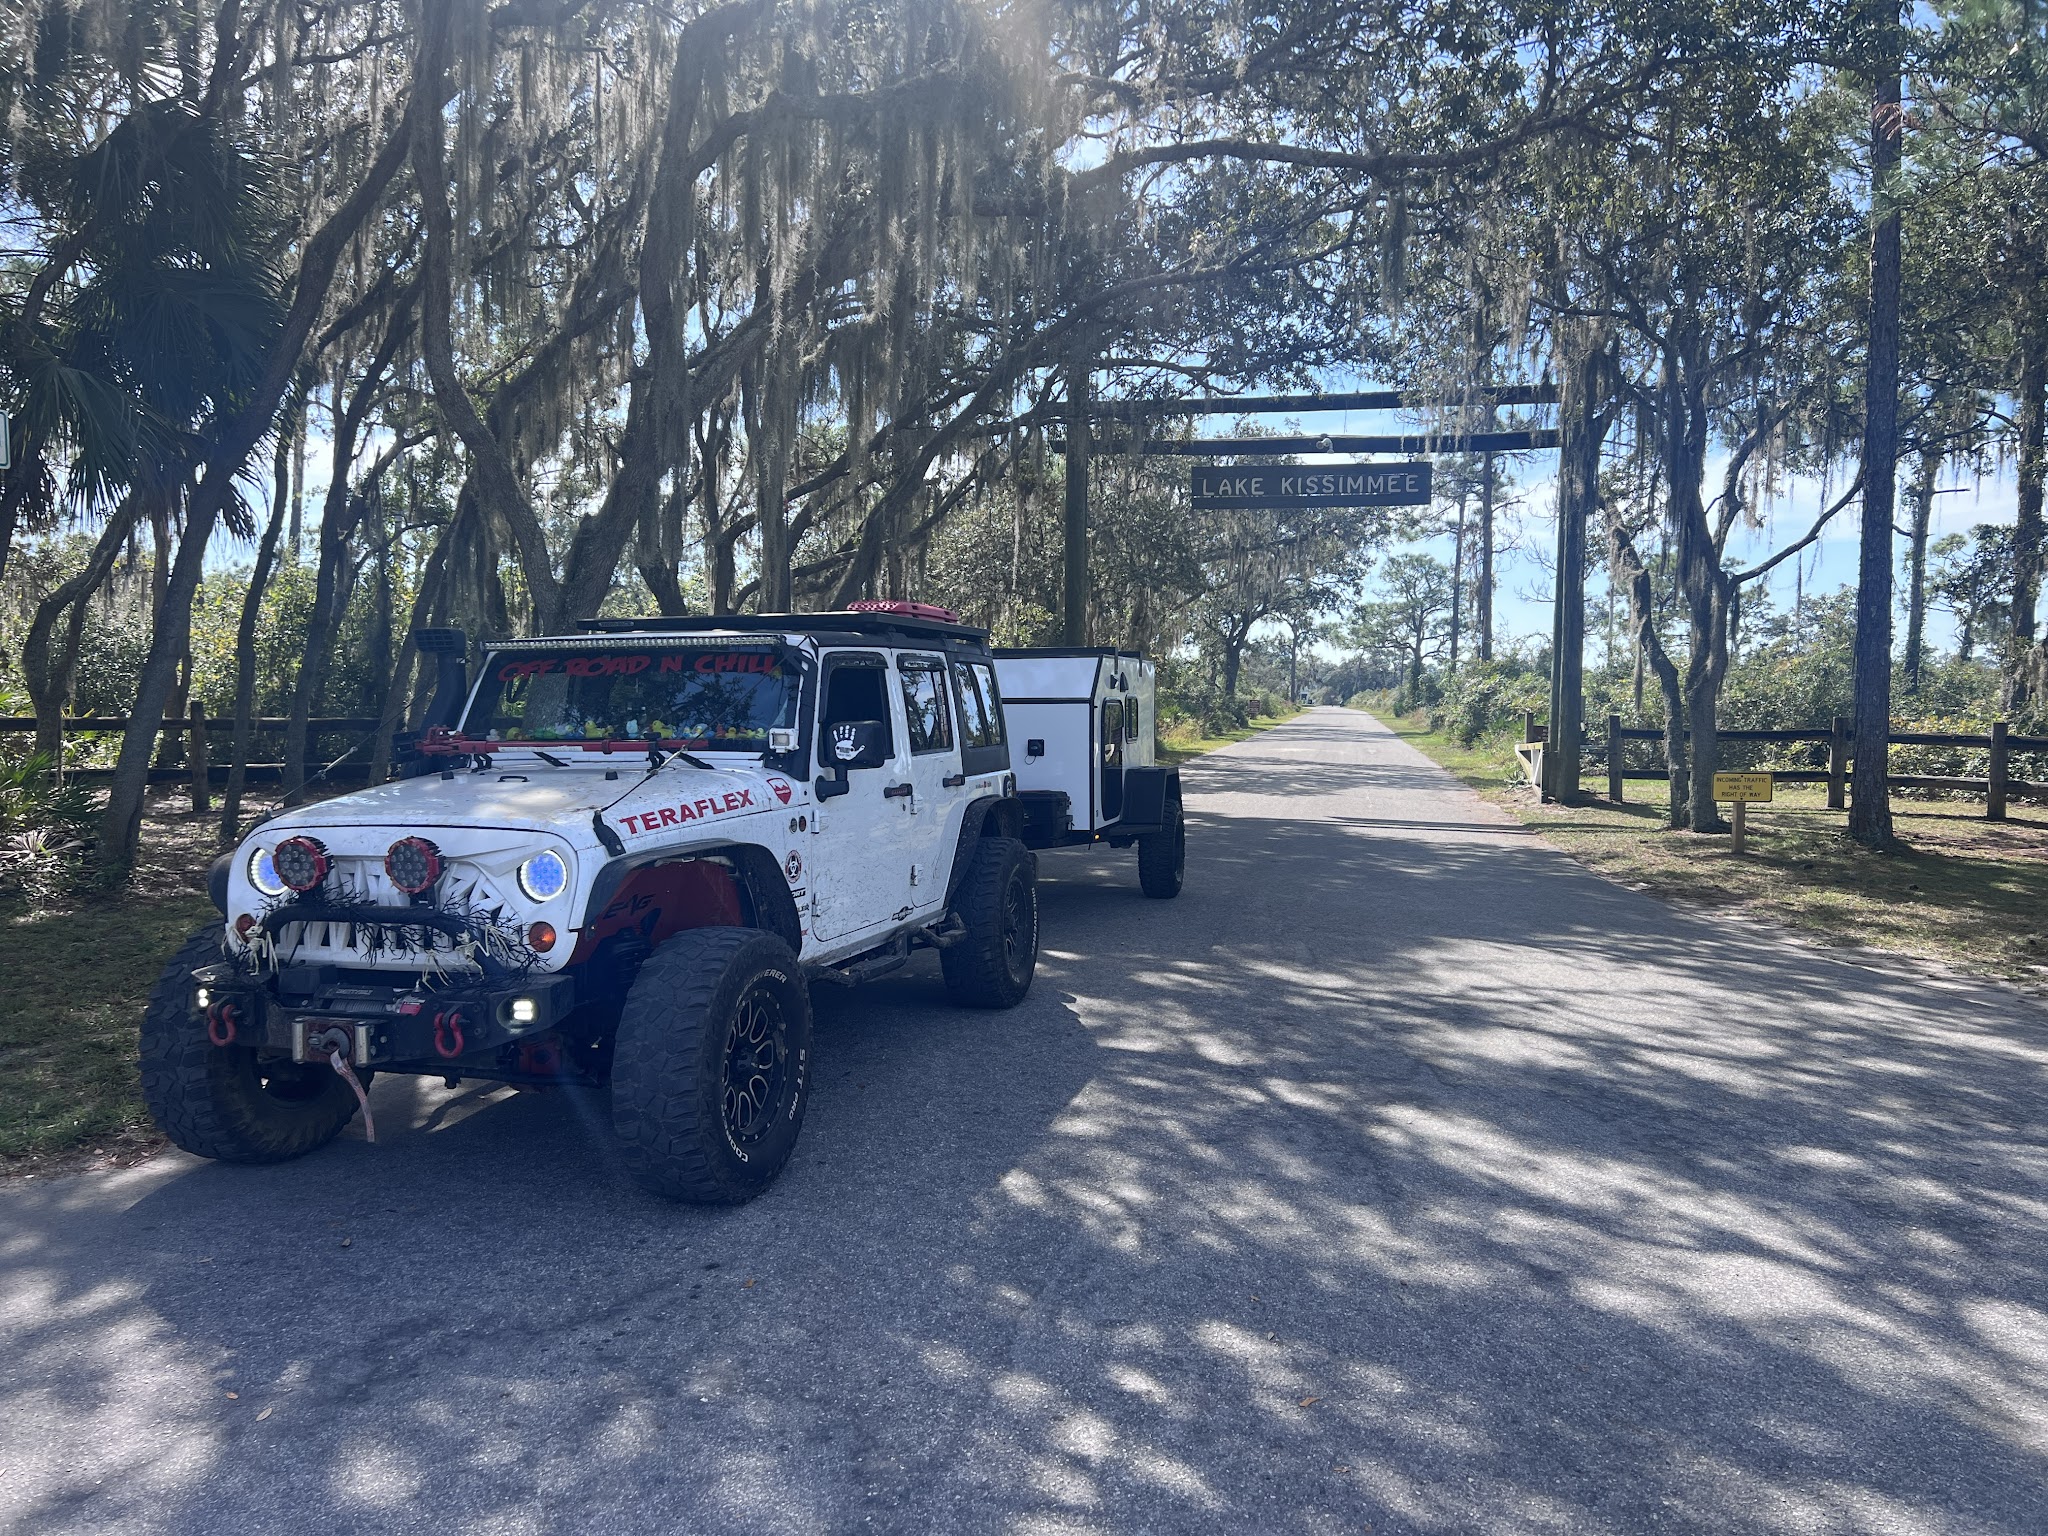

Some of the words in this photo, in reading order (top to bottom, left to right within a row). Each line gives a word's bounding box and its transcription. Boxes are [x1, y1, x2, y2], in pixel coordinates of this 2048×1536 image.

[1202, 477, 1265, 496] LAKE
[1281, 475, 1419, 495] KISSIMMEE
[498, 659, 558, 681] OFF
[564, 655, 651, 677] ROAD
[661, 655, 683, 672] N
[694, 653, 775, 673] CHILL
[619, 789, 754, 835] TERAFLEX
